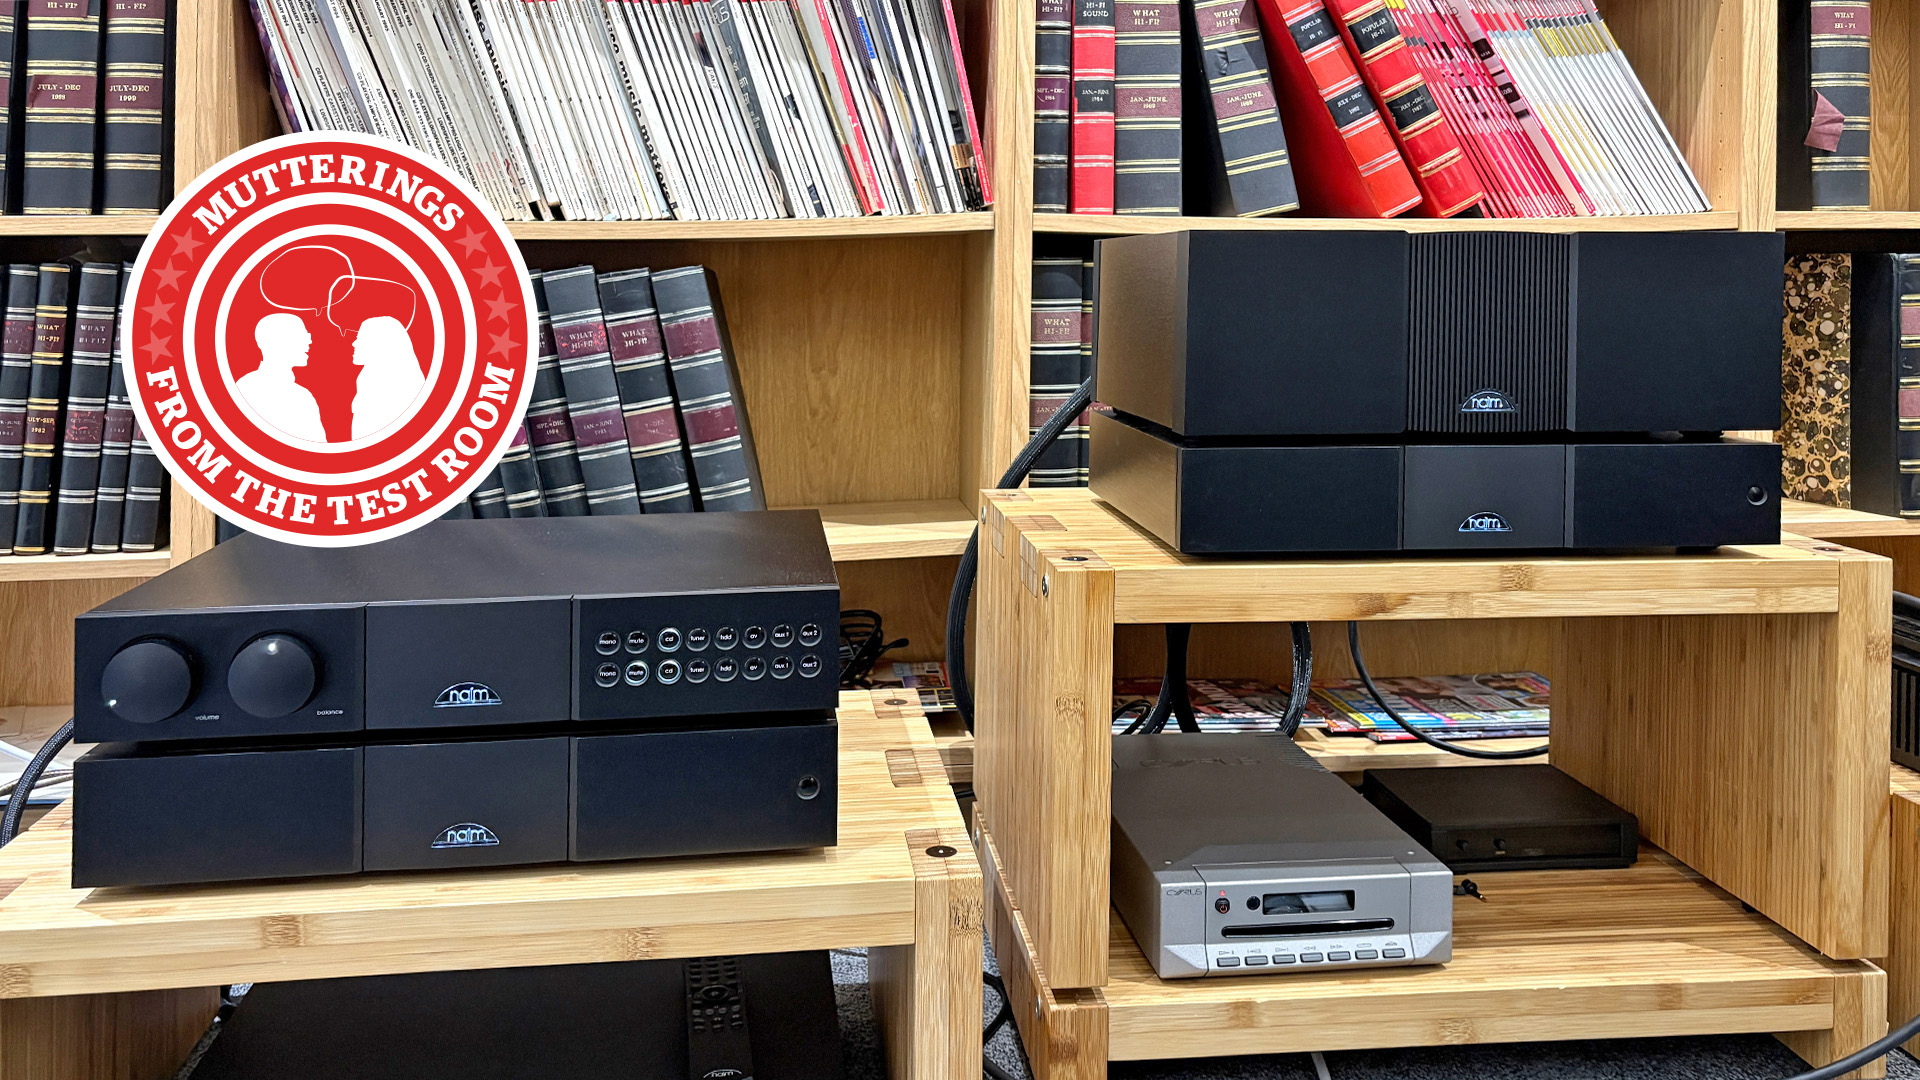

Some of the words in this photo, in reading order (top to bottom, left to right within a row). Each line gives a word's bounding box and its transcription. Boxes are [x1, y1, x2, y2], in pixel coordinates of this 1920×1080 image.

[1132, 9, 1160, 17] WHAT
[1213, 8, 1239, 19] WHAT
[1301, 18, 1322, 32] POPULAR
[1361, 17, 1388, 35] POPULAR
[483, 38, 513, 98] music
[80, 324, 106, 332] WHAT
[621, 328, 646, 338] WHAT
[569, 331, 594, 341] WHAT
[1471, 396, 1503, 409] naim
[1469, 516, 1501, 530] naim
[628, 669, 644, 677] mute
[449, 686, 489, 703] naim
[194, 713, 220, 721] volume
[447, 826, 488, 843] naim
[711, 1070, 734, 1078] naim
